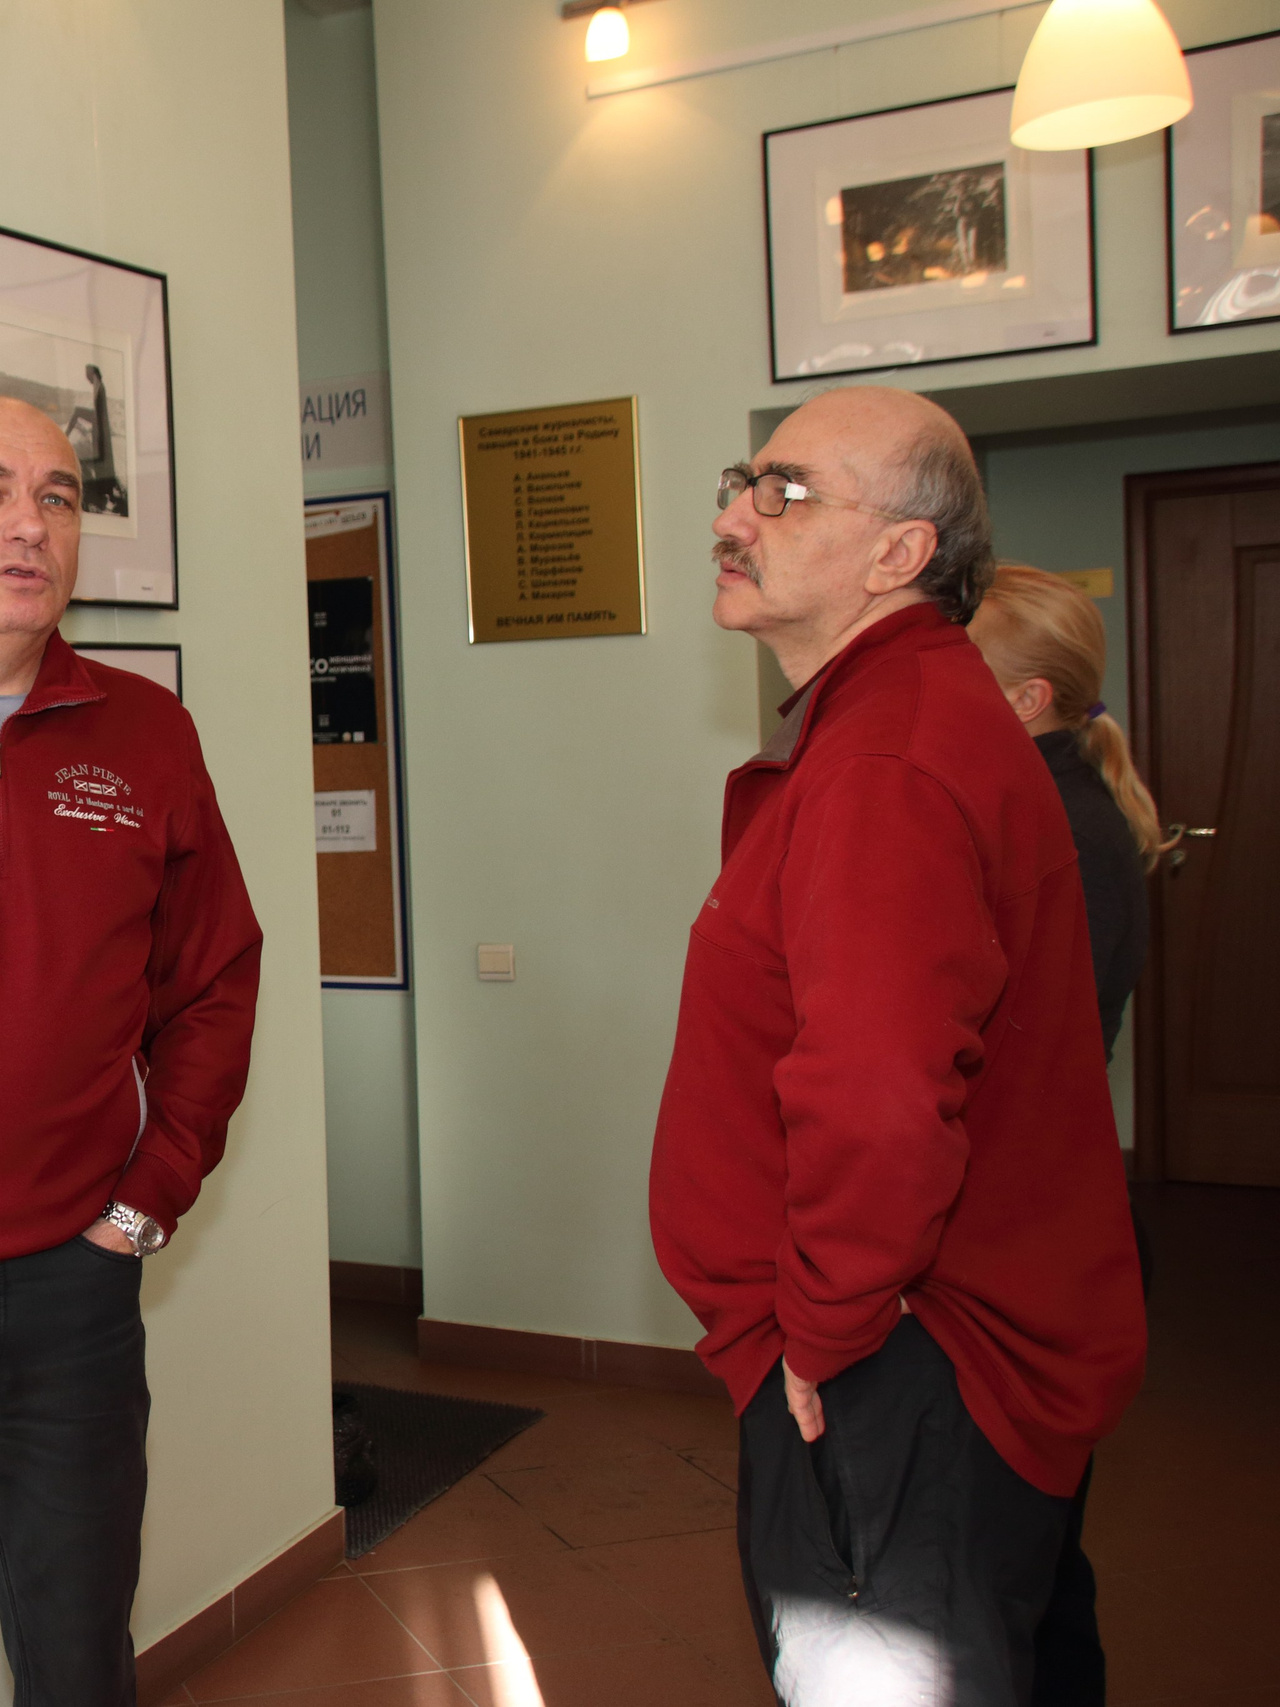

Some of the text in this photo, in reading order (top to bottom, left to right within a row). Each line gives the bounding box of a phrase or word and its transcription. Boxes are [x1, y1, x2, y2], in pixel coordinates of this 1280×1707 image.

[513, 445, 567, 459] 1941-1945
[496, 610, 617, 628] ВЕЧНАЯ ИМ ПАМЯТЬ
[54, 763, 89, 784] JEAN
[47, 790, 71, 803] ROYAL
[53, 803, 141, 829] Exclusive Wear
